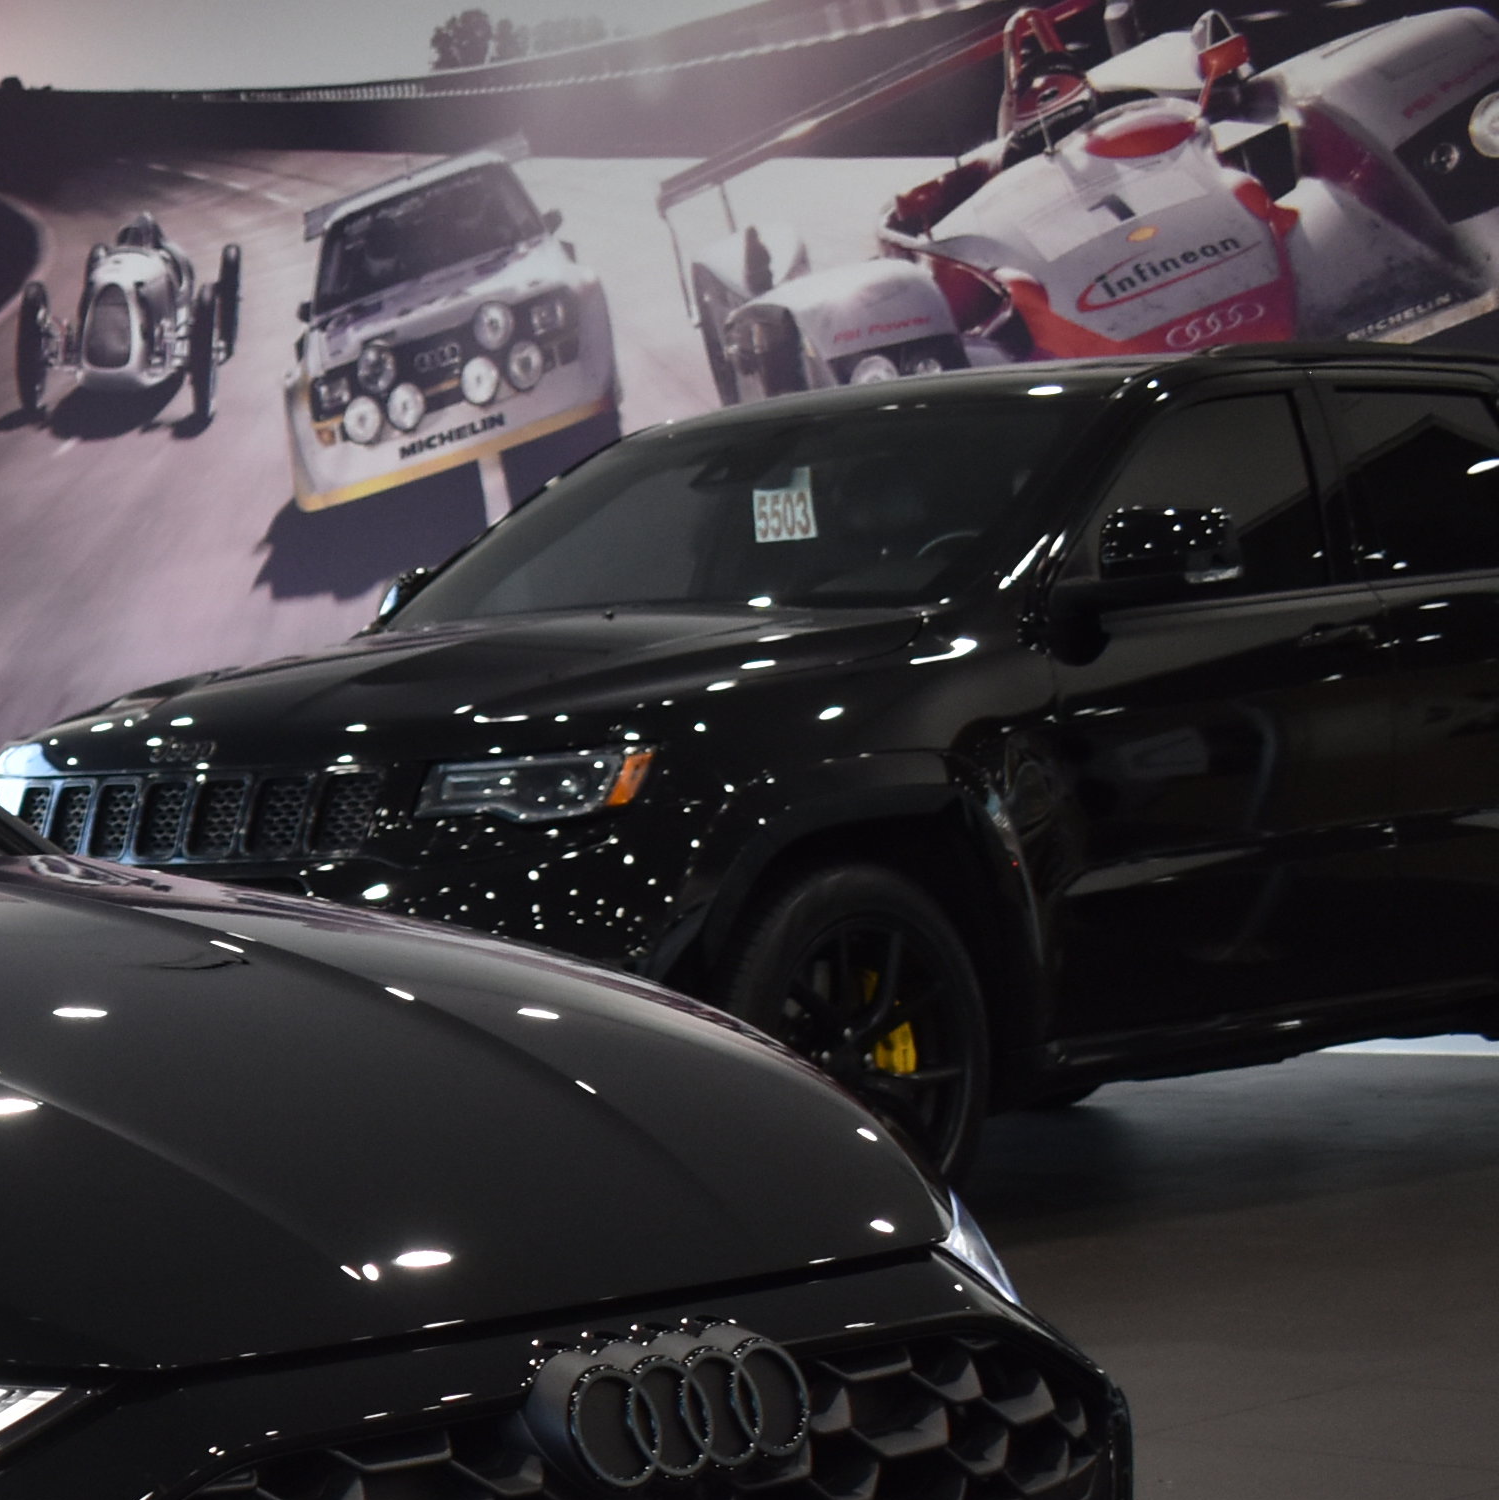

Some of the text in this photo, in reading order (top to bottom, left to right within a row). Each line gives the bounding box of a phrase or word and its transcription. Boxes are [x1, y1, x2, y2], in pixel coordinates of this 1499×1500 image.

[1095, 237, 1241, 299] Infineon
[398, 412, 506, 460] MICHELIN
[757, 491, 812, 539] 5503
